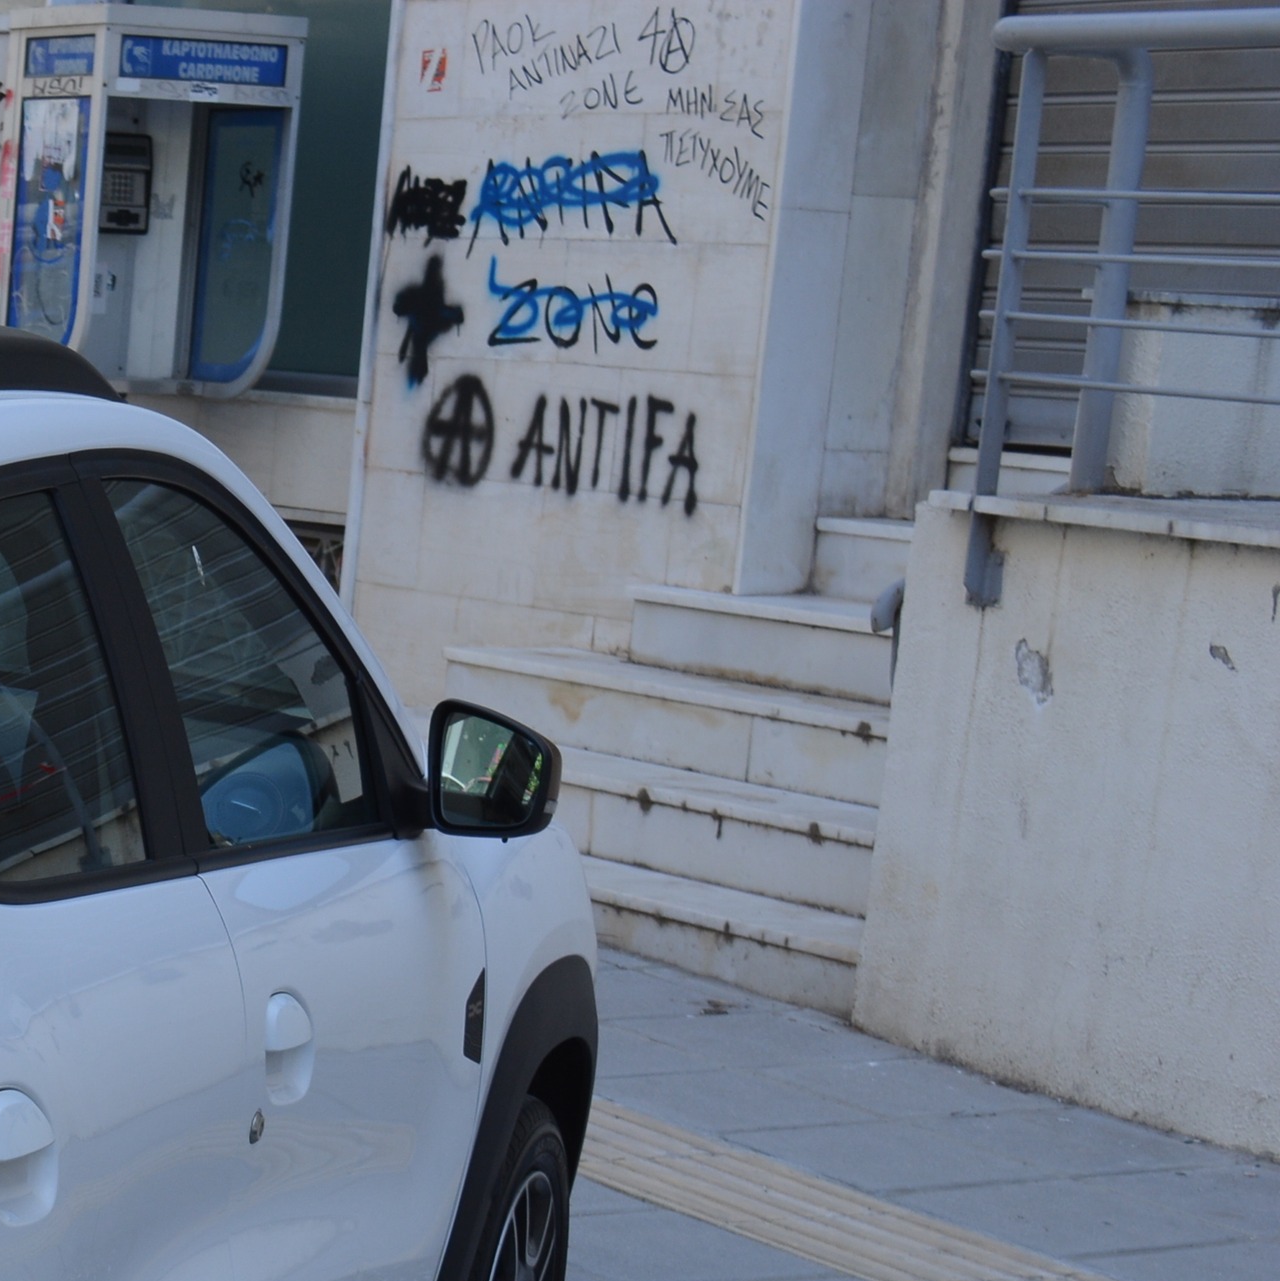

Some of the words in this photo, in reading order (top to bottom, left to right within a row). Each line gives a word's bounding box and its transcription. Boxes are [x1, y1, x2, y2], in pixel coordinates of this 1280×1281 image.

[178, 61, 260, 83] CARDPHONE
[472, 14, 556, 74] PAOK
[509, 22, 621, 99] ANTINAZI
[511, 394, 699, 517] ANTIFA
